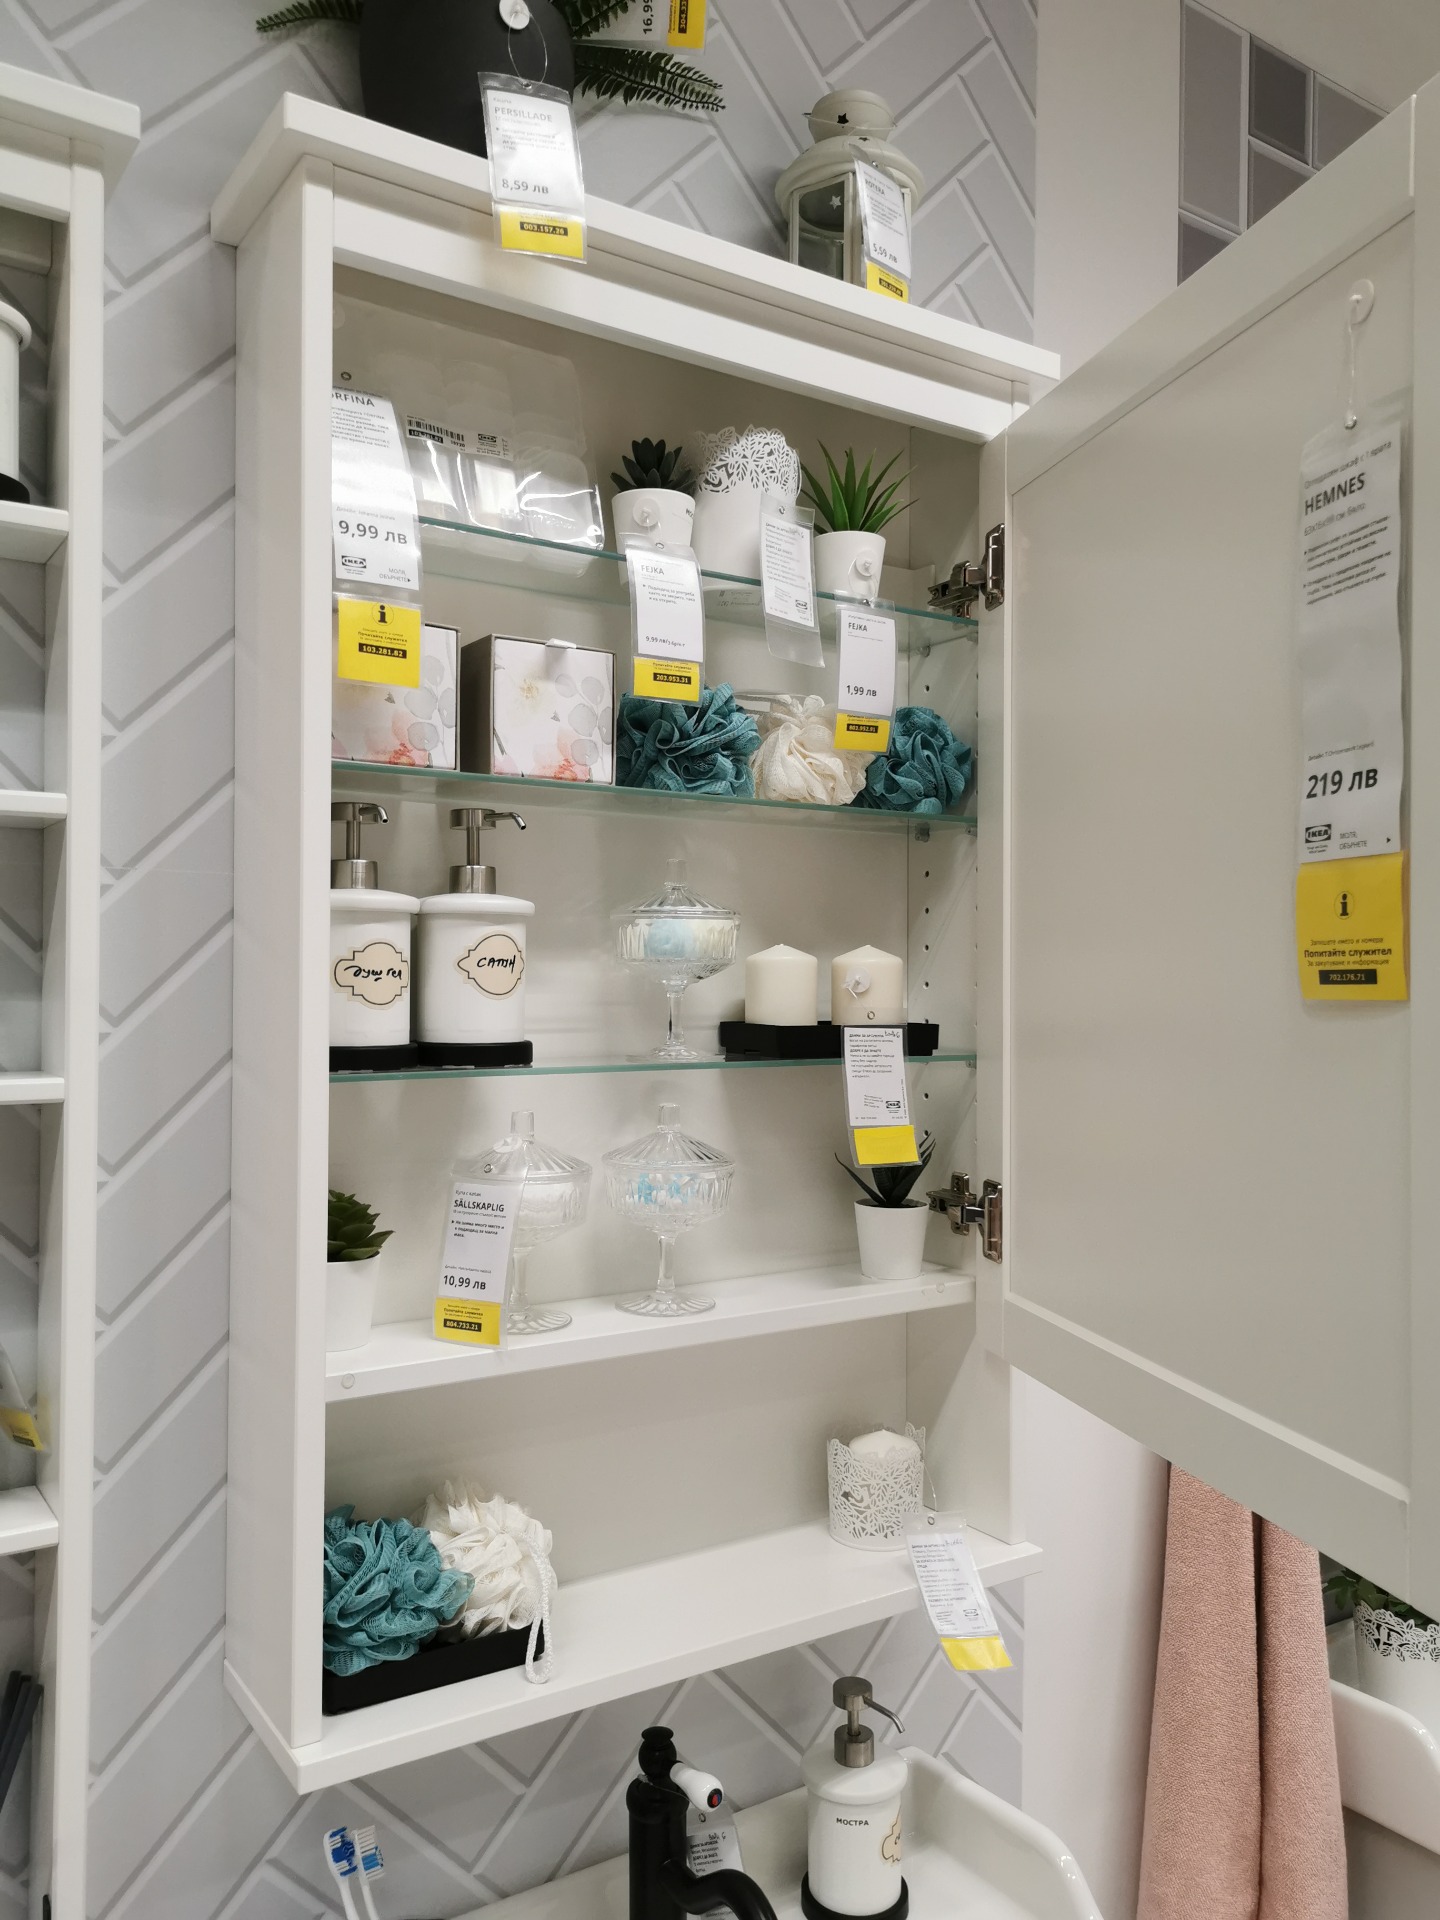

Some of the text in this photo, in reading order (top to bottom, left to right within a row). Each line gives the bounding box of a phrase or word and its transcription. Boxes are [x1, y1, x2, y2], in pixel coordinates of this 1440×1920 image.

[494, 106, 553, 122] PERSILLADE
[502, 178, 549, 194] 8,59 лв
[865, 178, 885, 196] ROTERA
[873, 243, 888, 257] 5,59
[1304, 472, 1365, 516] HEMNES
[338, 520, 408, 544] 9,99 лв
[342, 557, 366, 567] IKEA
[640, 564, 665, 575] FEJKA
[379, 573, 407, 582] ОБЪРНЕТЕ
[848, 622, 868, 632] FEJKA
[645, 635, 658, 643] 9,99
[362, 645, 404, 657] 103.281.82
[656, 674, 688, 683] 203.953.31
[846, 685, 877, 697] 1,99 лв
[1306, 768, 1378, 799] 219 лв
[1306, 827, 1330, 840] IKEA
[1339, 840, 1368, 850] ОБЪРНЕТЕ
[1304, 948, 1392, 958] Попитайте служител
[453, 1198, 505, 1213] SÄLLSKAPLIG
[443, 1275, 486, 1290] 10,99 лв
[835, 1817, 870, 1826] МОСТРА
